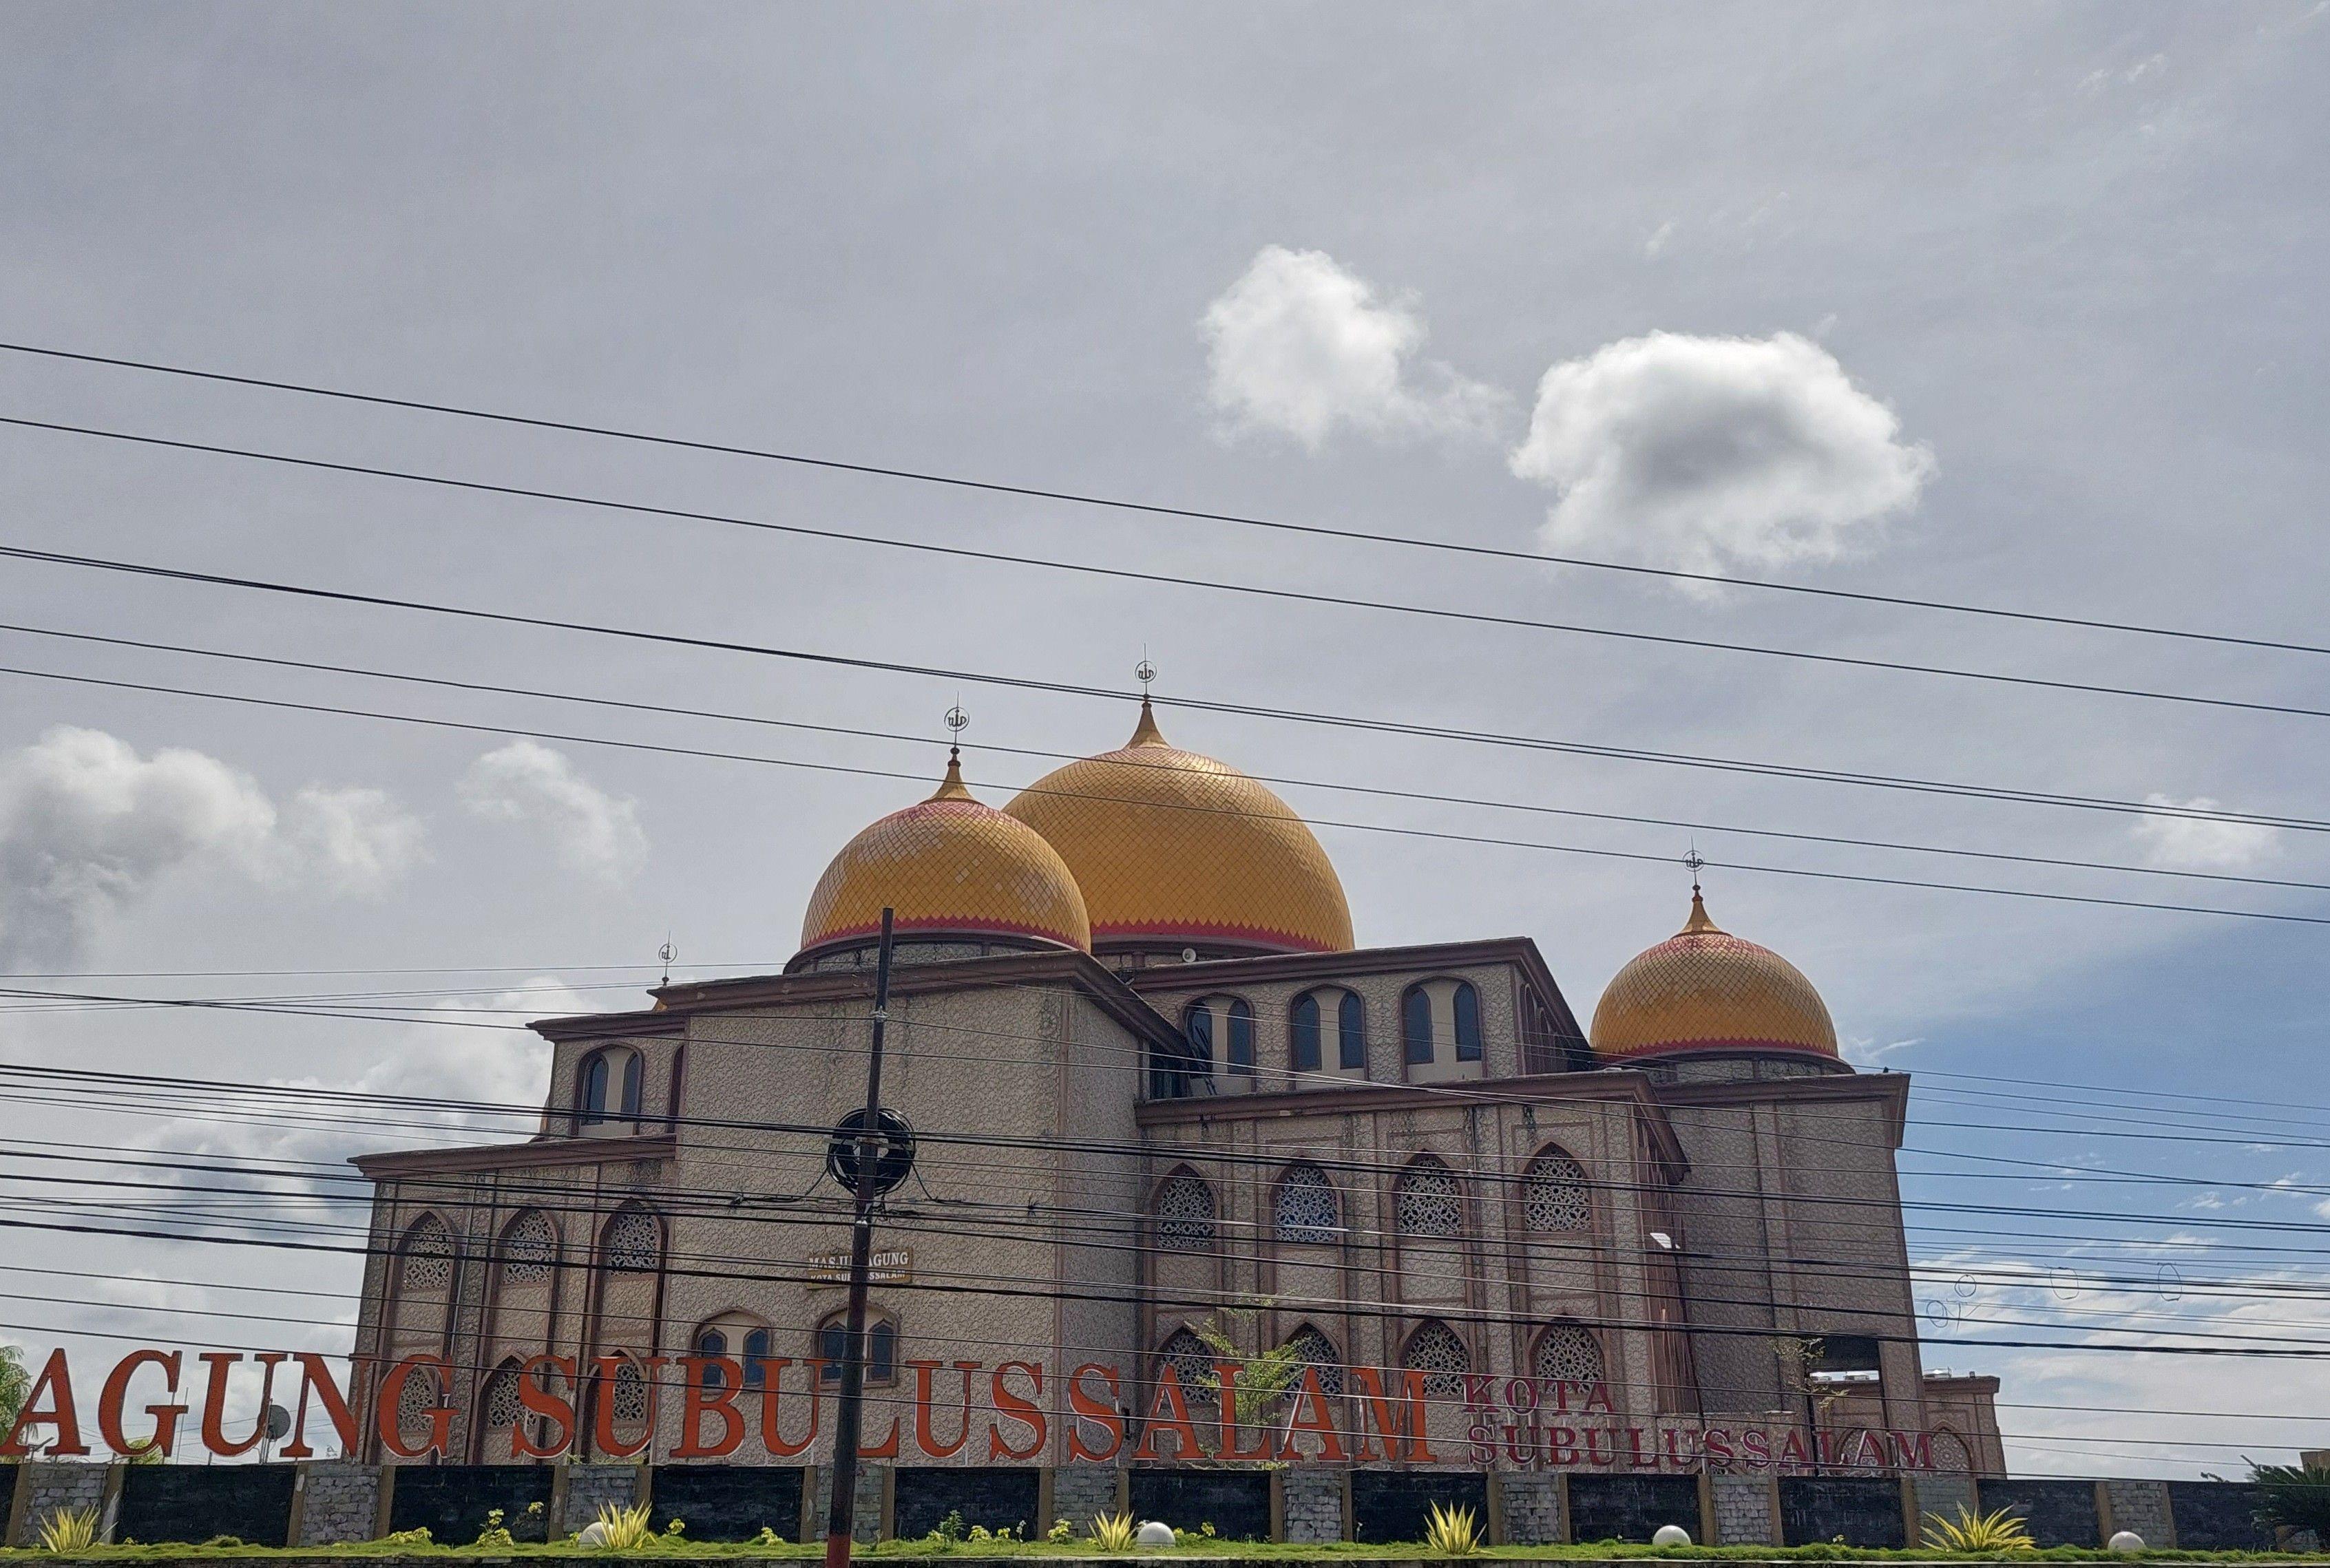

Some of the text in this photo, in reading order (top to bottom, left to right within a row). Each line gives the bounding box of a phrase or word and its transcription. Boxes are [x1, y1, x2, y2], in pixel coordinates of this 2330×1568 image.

[808, 1256, 852, 1271] MASJI
[0, 1348, 460, 1458] AGUNG
[1464, 1374, 1618, 1417] KOTA
[1467, 1423, 1938, 1471] SUBULUSSALAM
